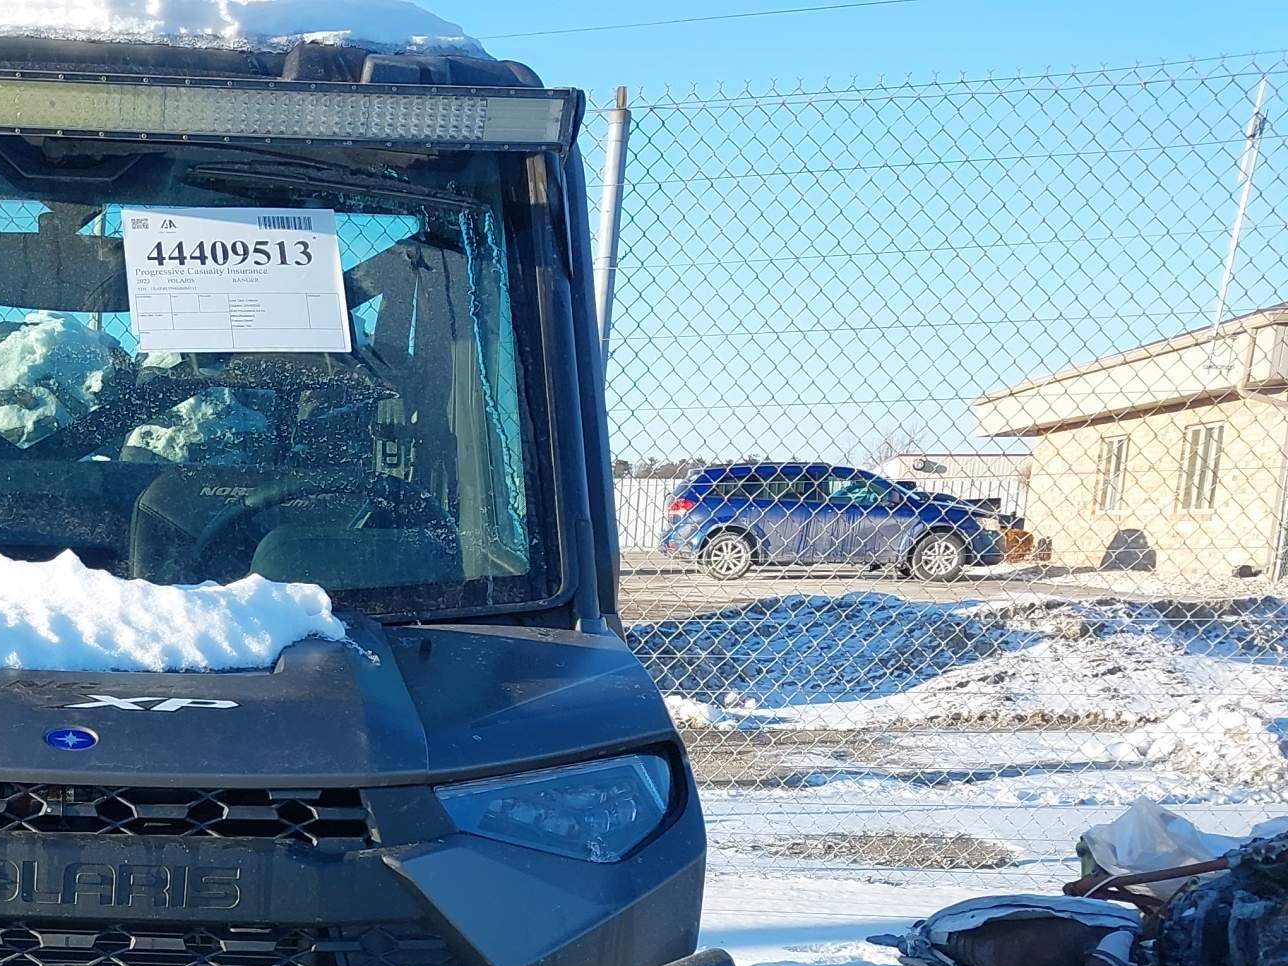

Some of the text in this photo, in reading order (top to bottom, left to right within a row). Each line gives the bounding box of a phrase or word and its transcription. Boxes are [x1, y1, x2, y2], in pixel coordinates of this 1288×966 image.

[147, 240, 313, 266] 44409513
[135, 267, 268, 276] Progressive Casualty Insurance
[62, 694, 242, 712] XP
